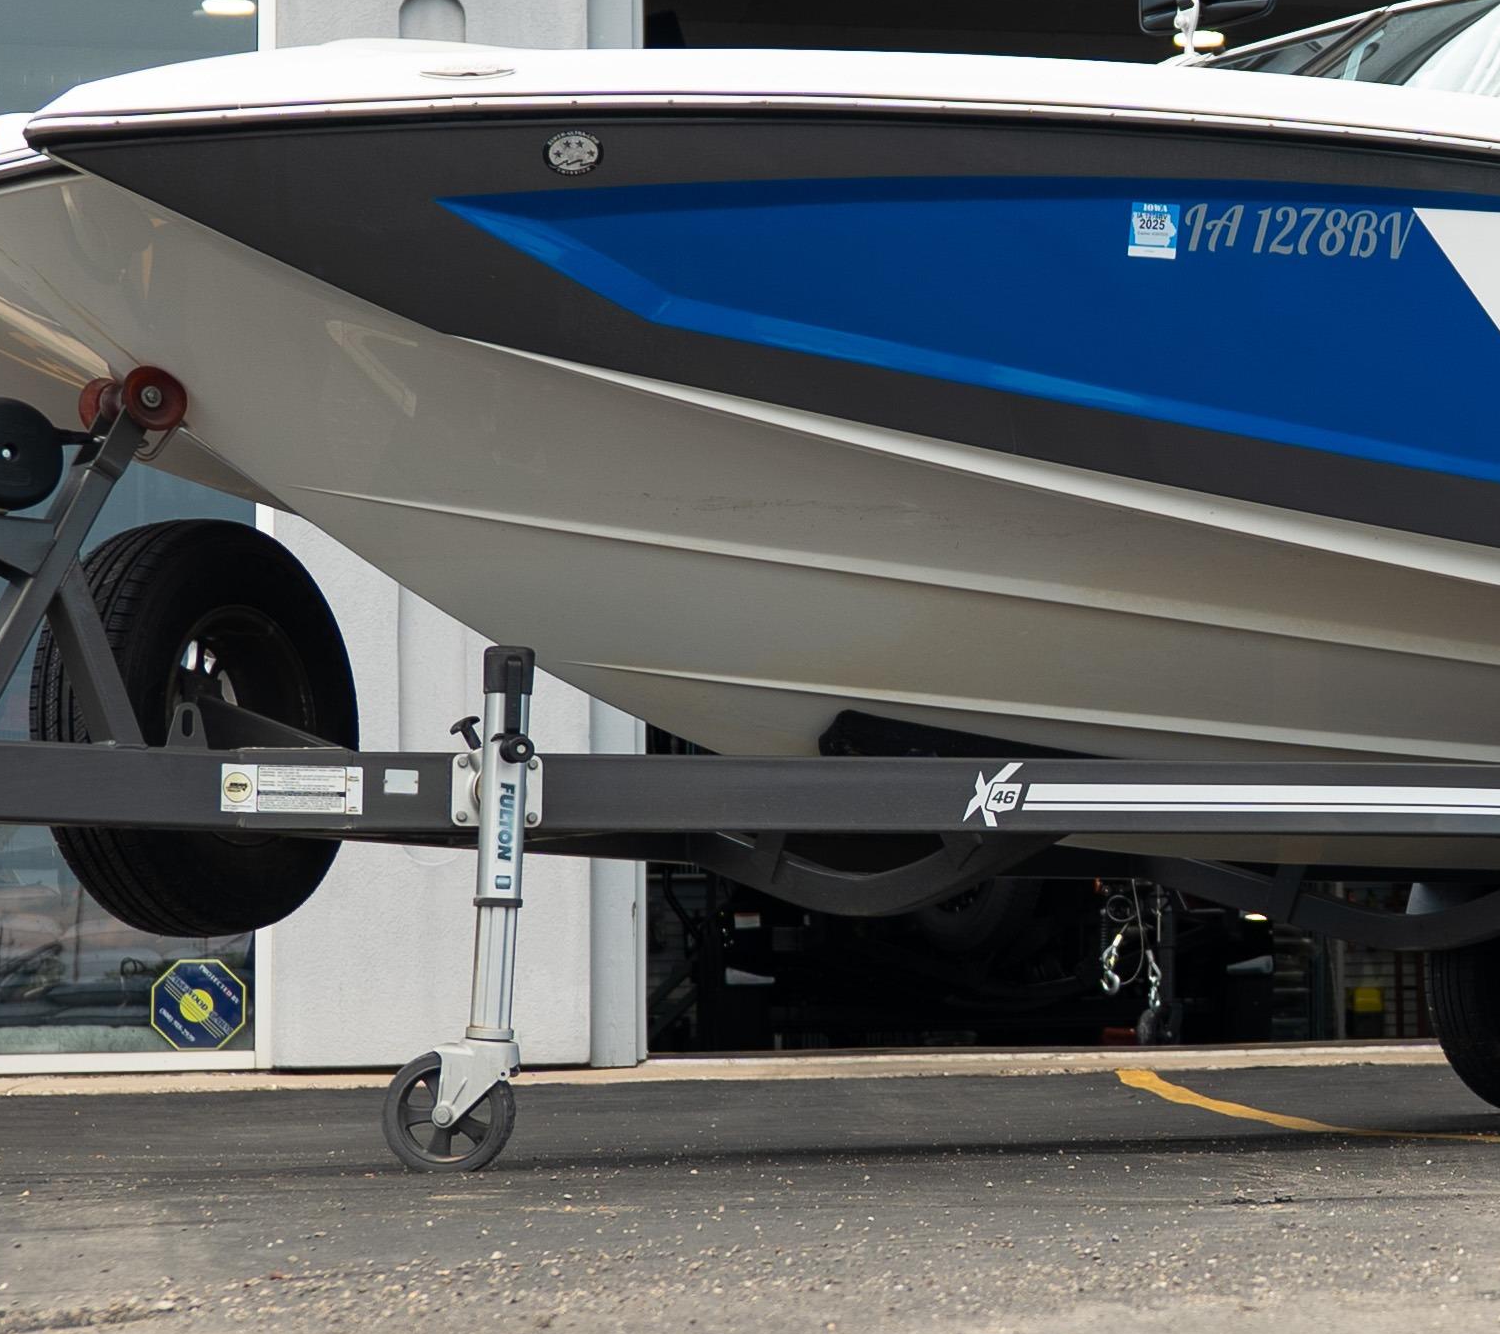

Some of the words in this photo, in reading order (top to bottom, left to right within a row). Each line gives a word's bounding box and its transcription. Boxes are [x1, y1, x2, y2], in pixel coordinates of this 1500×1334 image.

[1139, 219, 1166, 231] 2025
[1143, 203, 1168, 213] IOWA
[1185, 203, 1244, 252] IA
[1253, 206, 1416, 260] 1278BV
[497, 782, 516, 862] FULTON
